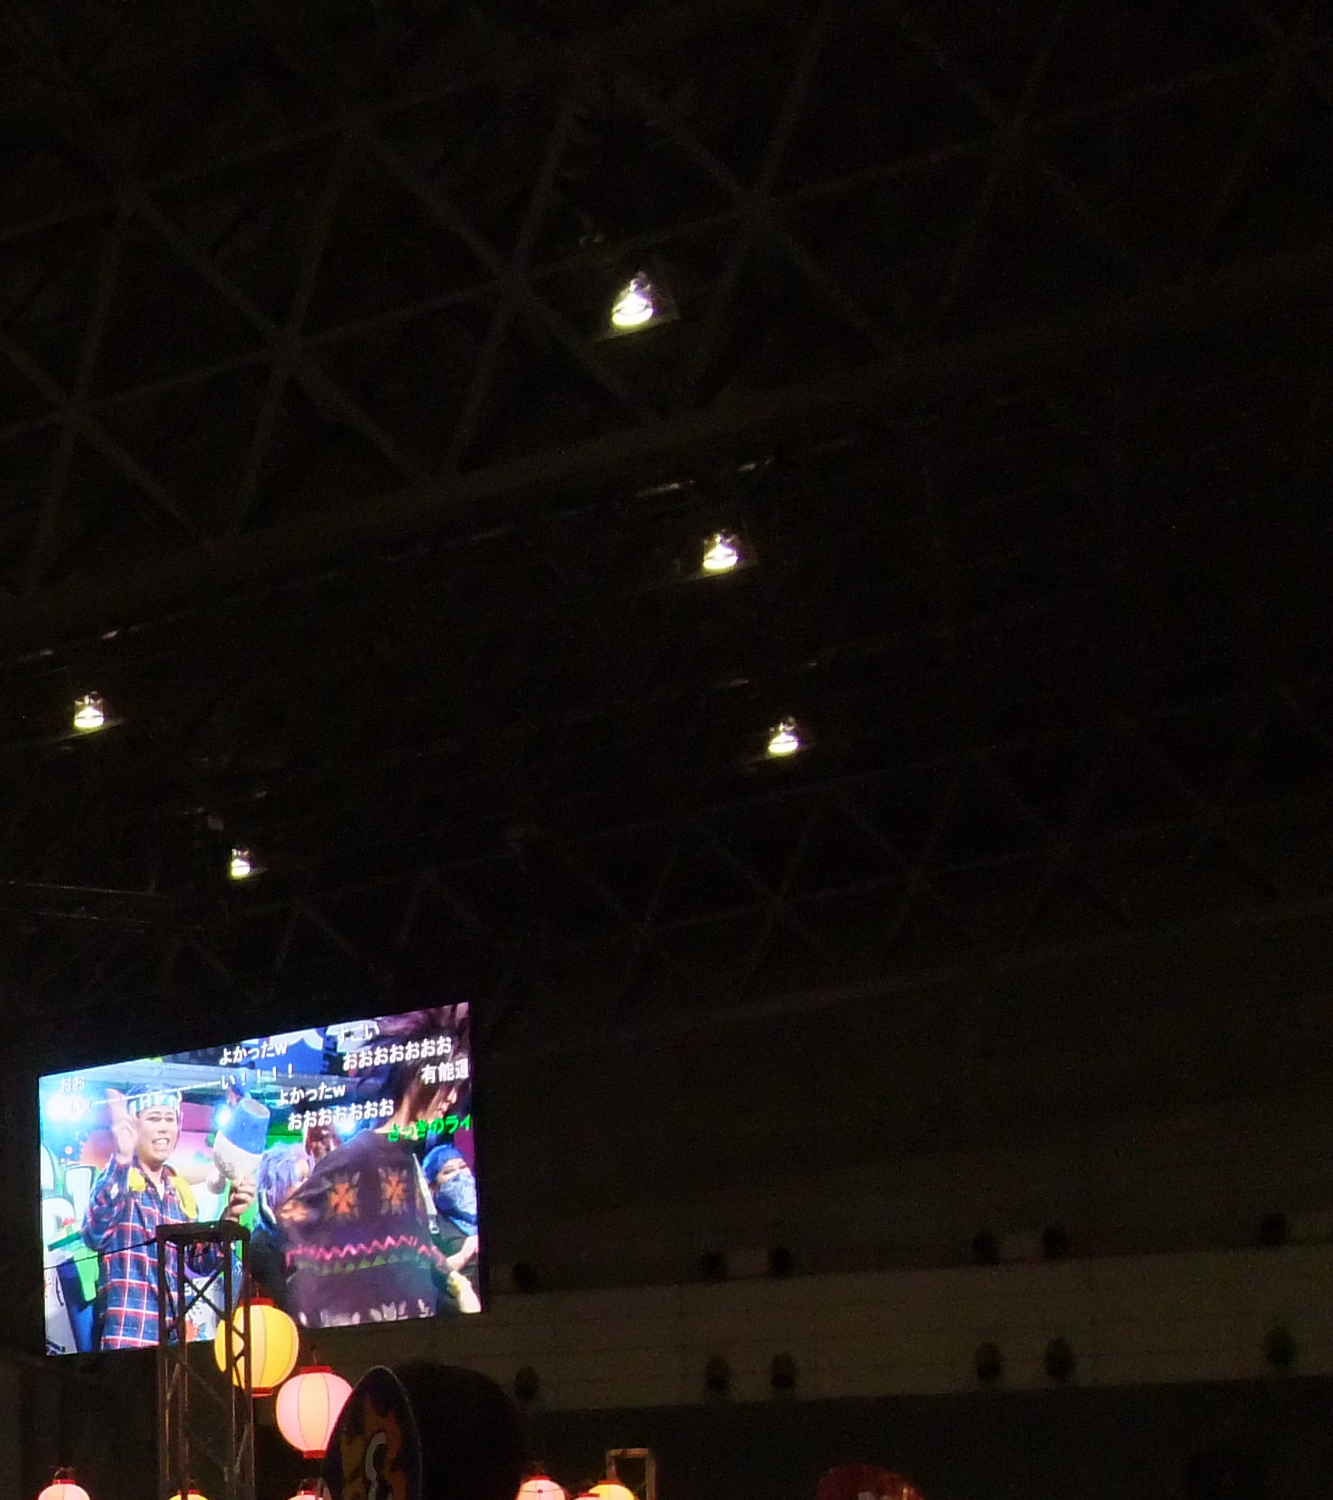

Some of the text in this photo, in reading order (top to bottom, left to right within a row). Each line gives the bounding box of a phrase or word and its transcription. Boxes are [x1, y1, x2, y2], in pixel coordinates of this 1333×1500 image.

[343, 1036, 452, 1071] おおおおおおお
